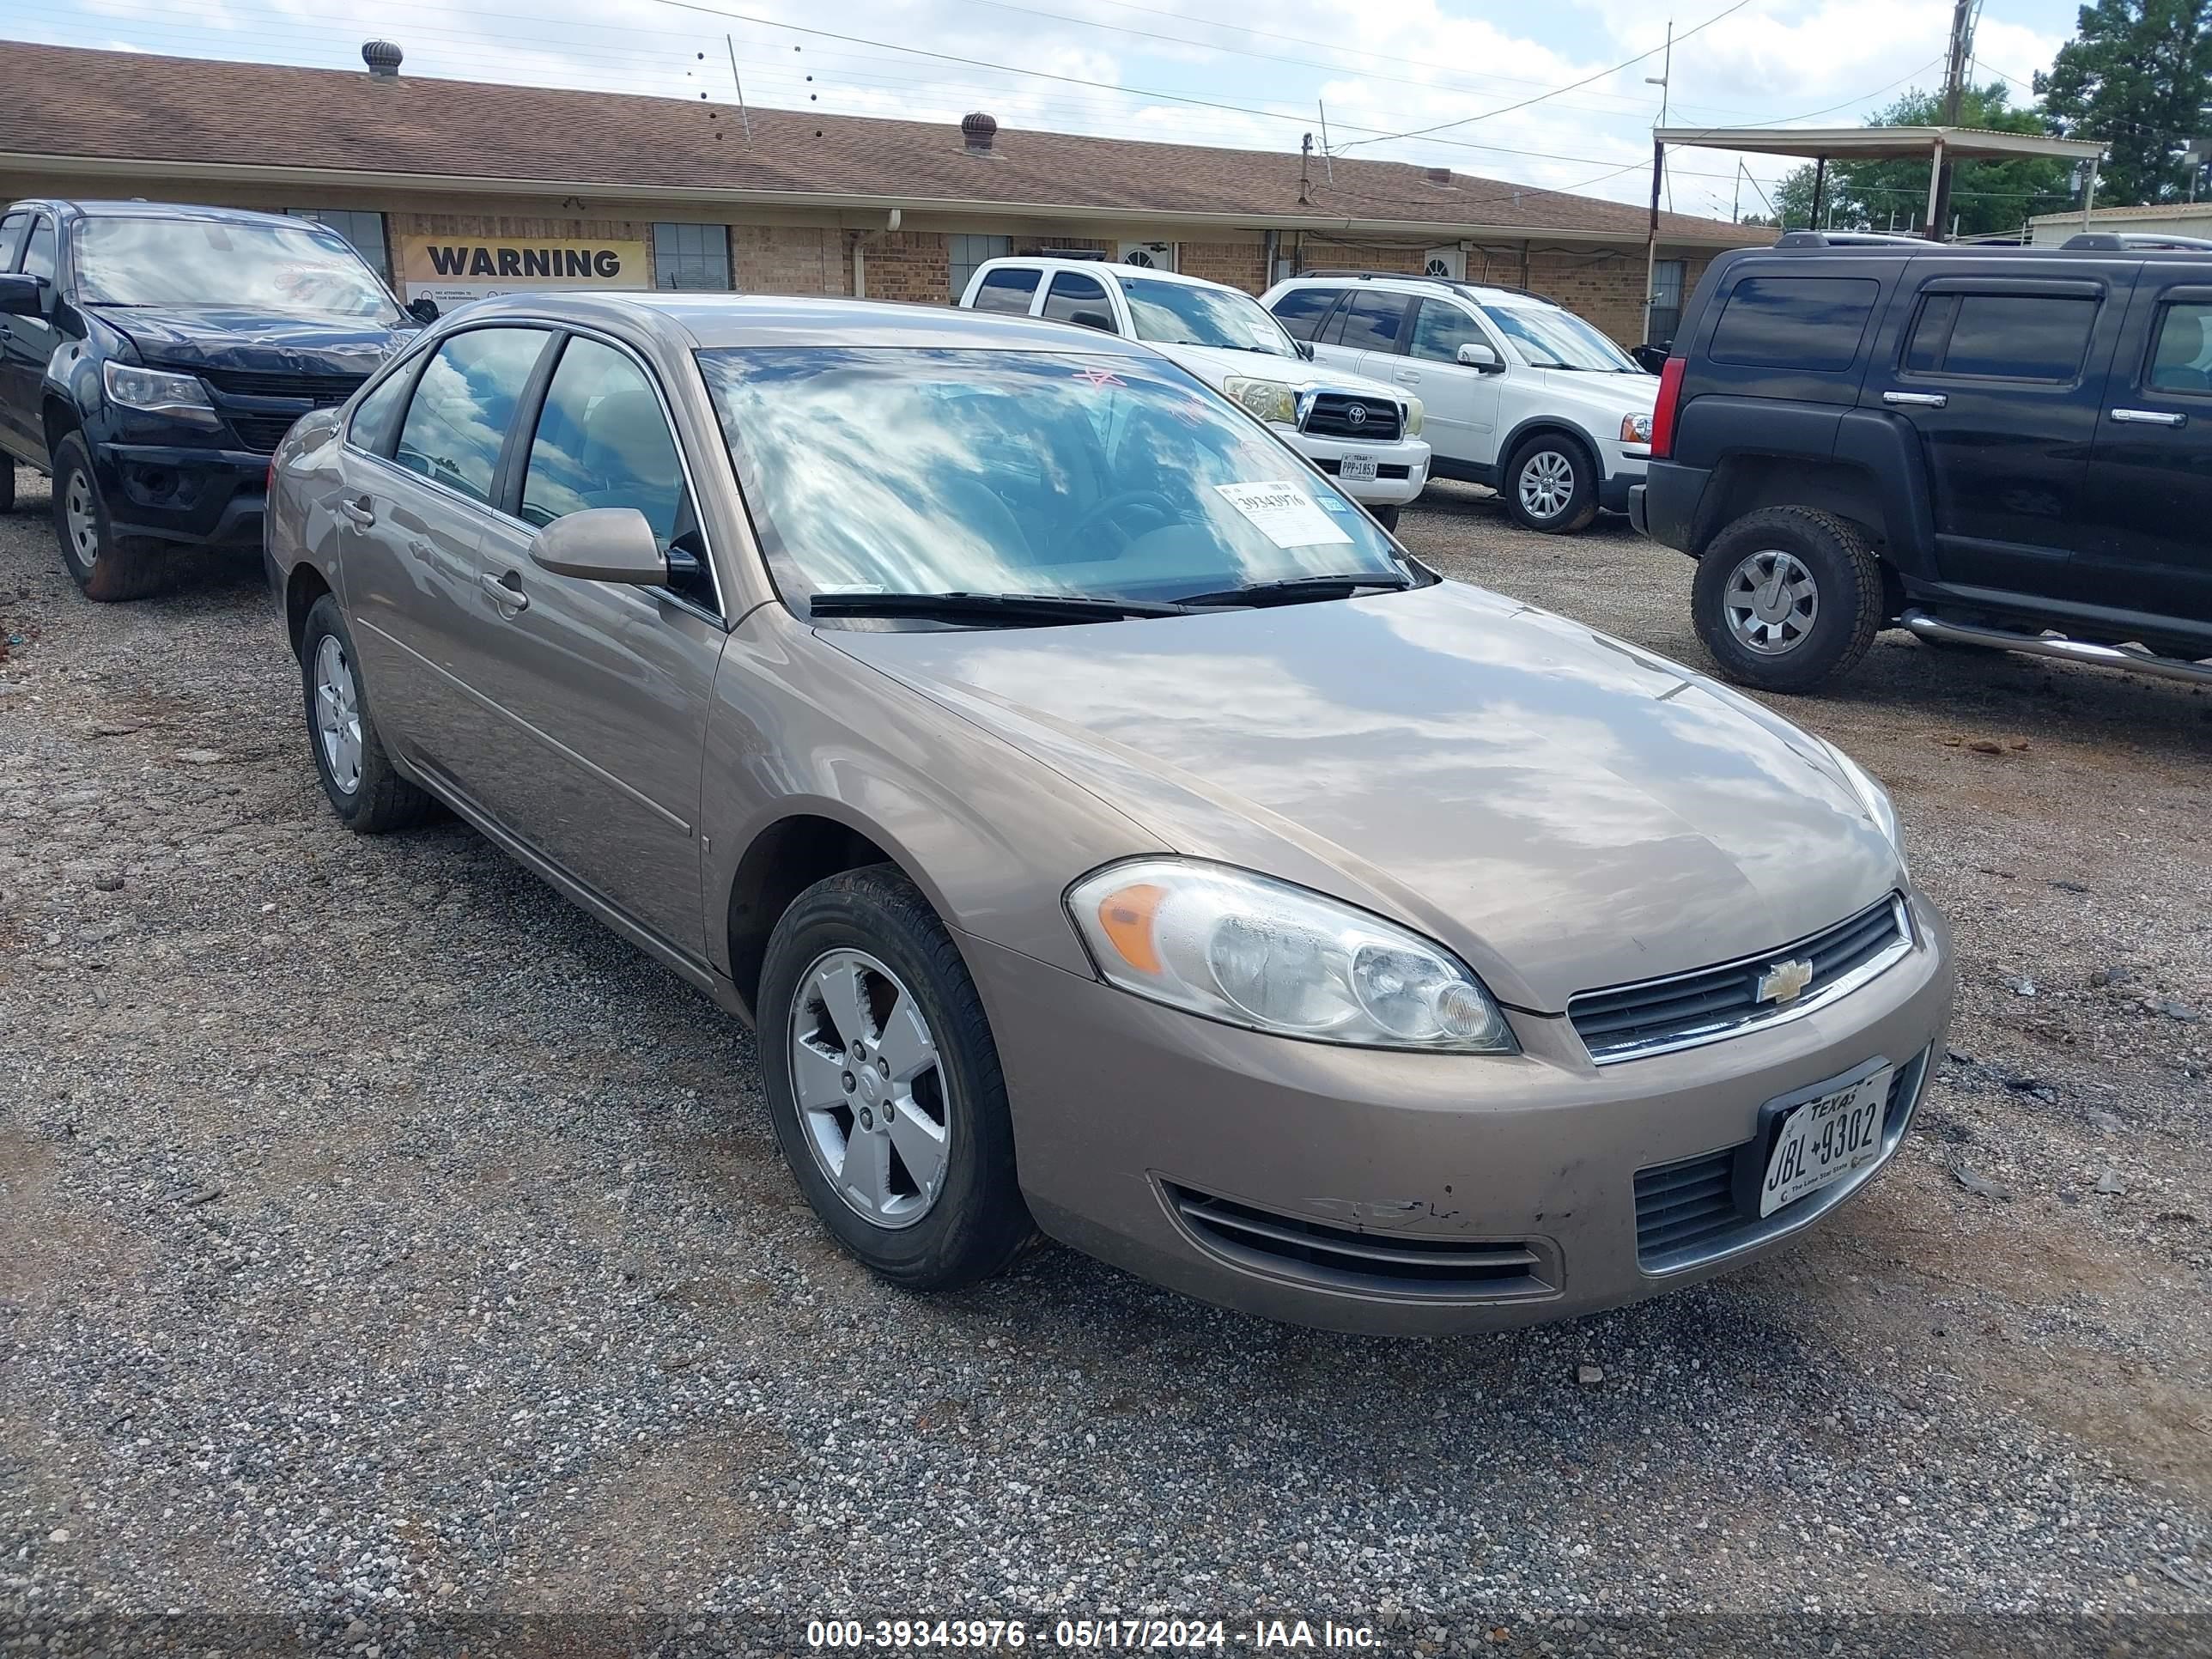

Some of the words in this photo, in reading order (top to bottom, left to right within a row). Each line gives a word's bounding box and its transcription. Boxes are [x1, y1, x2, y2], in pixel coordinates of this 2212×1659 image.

[427, 246, 620, 277] WARNING
[1238, 495, 1306, 510] 39343976
[1811, 1090, 1856, 1121] TEXAS
[1791, 1183, 1803, 1193] The
[1804, 1177, 1819, 1187] Lone
[1820, 1170, 1832, 1180] Star
[1833, 1163, 1848, 1174] State
